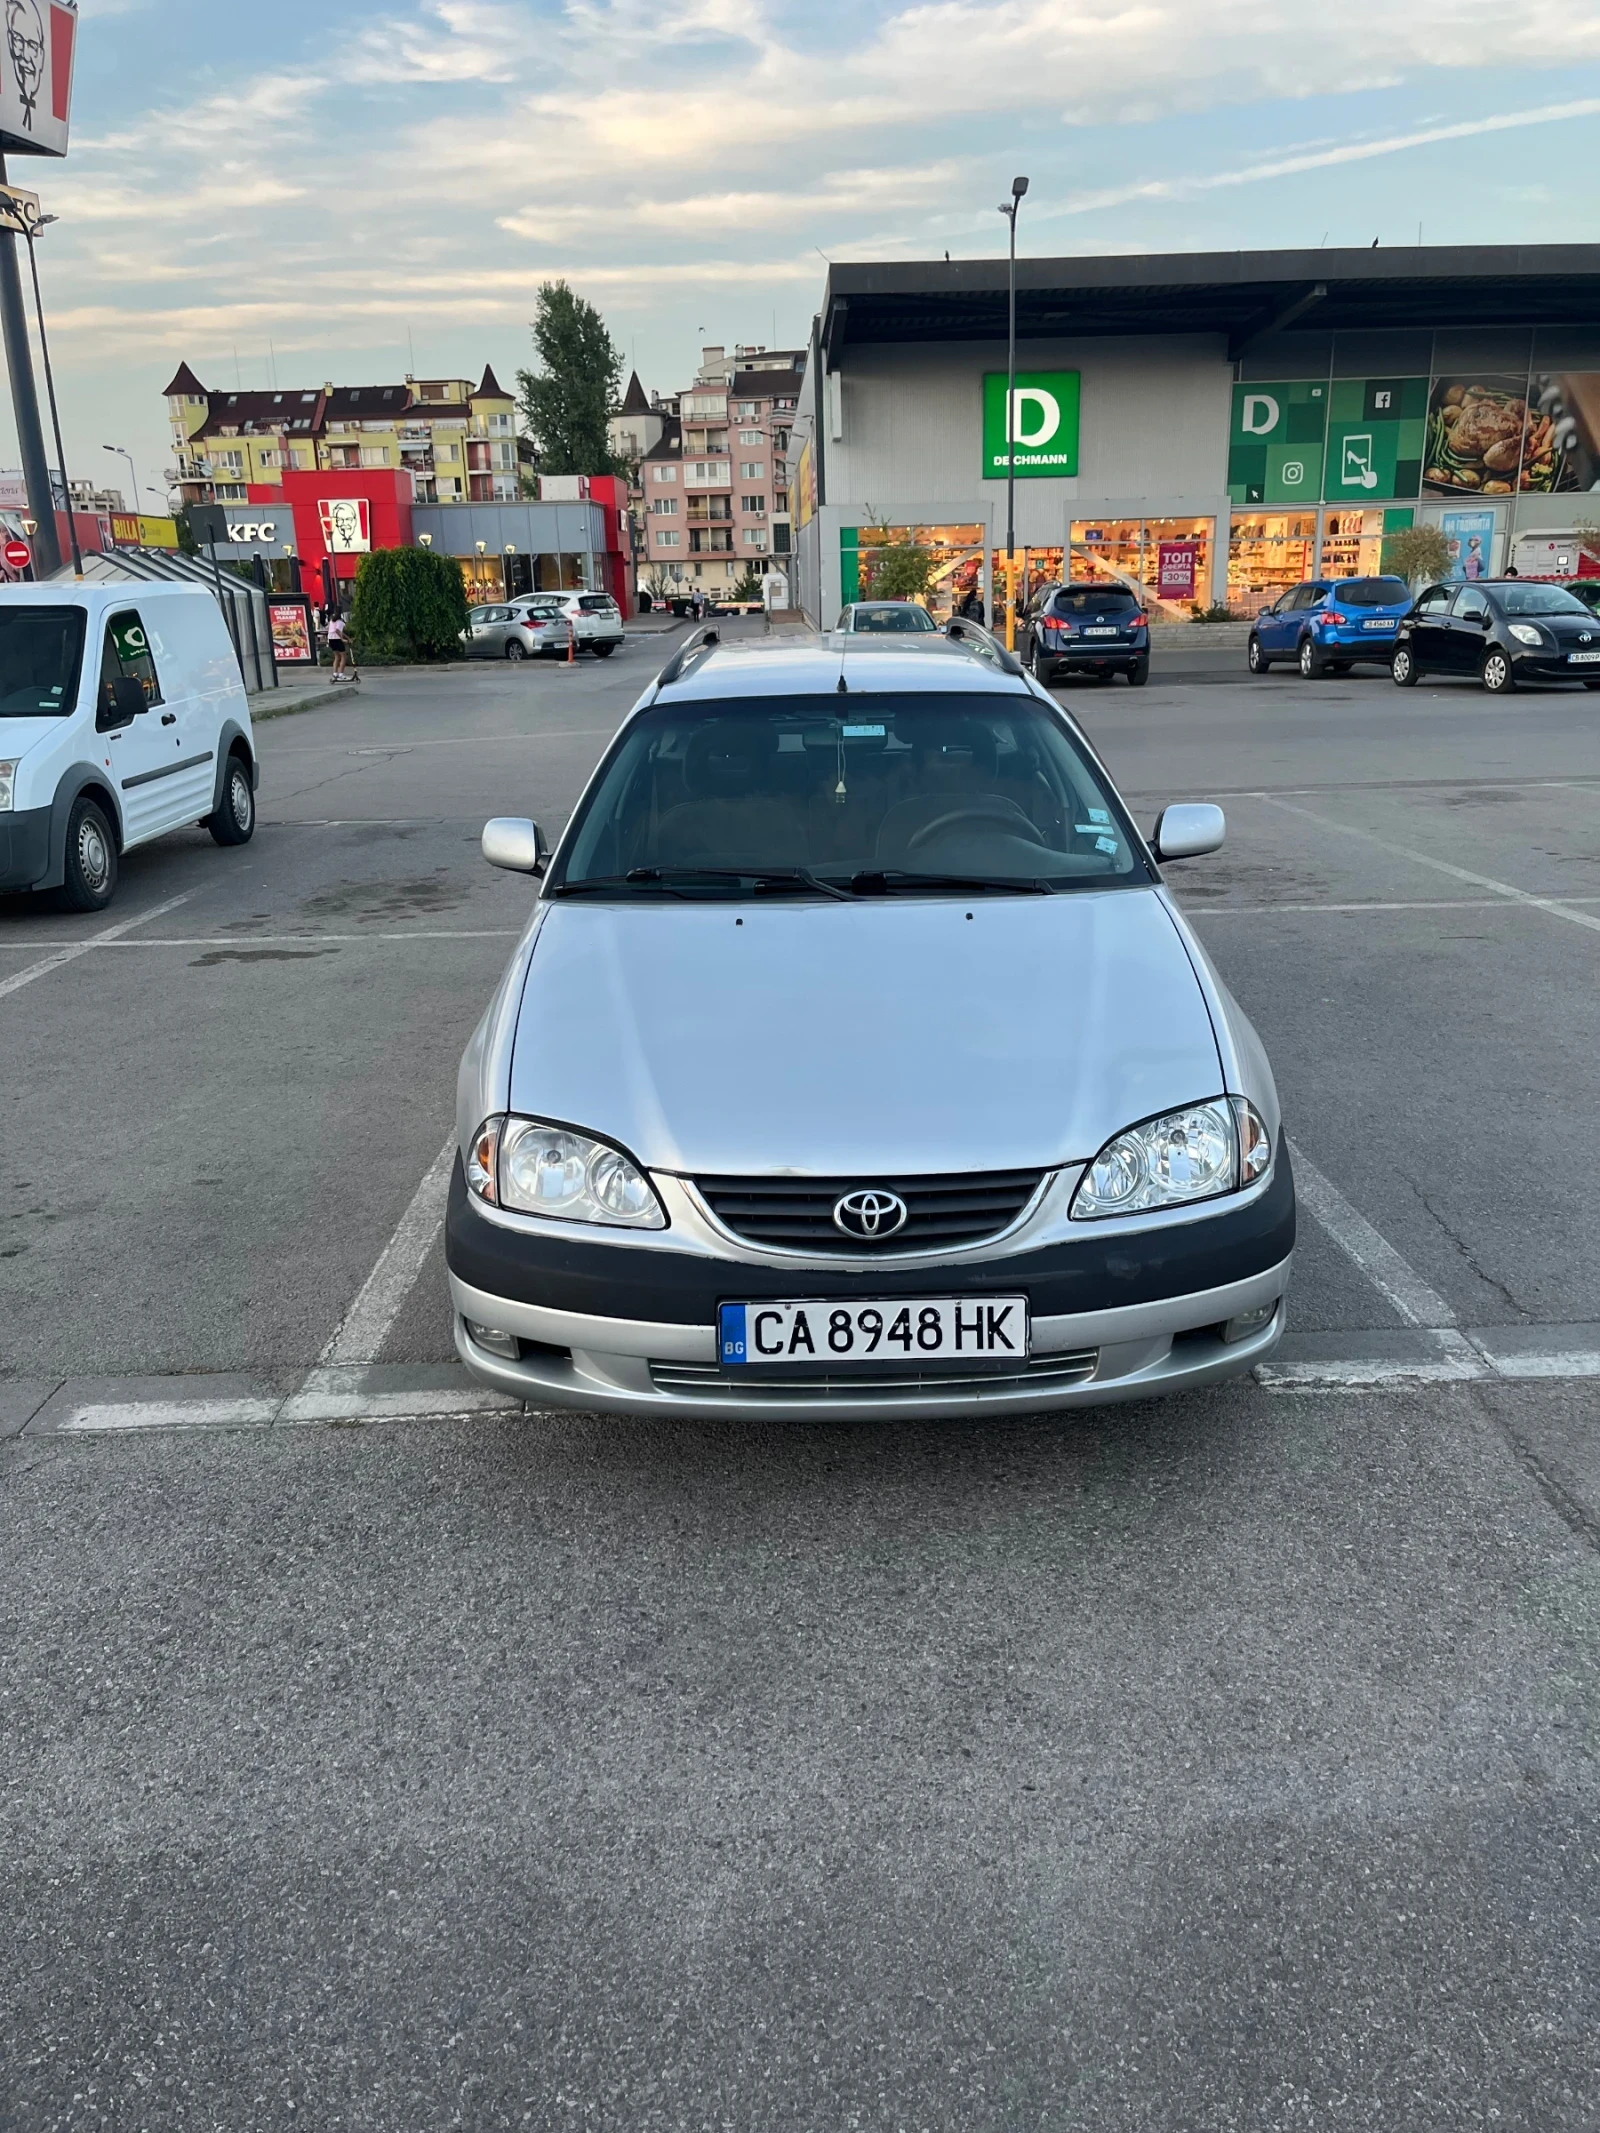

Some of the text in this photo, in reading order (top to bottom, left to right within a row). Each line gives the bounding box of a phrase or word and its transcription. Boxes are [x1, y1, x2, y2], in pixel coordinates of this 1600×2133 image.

[1006, 388, 1060, 447] D
[993, 454, 1068, 466] DECHMANN
[113, 519, 138, 540] BILLA
[227, 523, 276, 542] KFC
[1162, 552, 1192, 564] ТОП
[754, 1304, 1016, 1355] CA 8948 HK
[724, 1340, 745, 1356] BG
